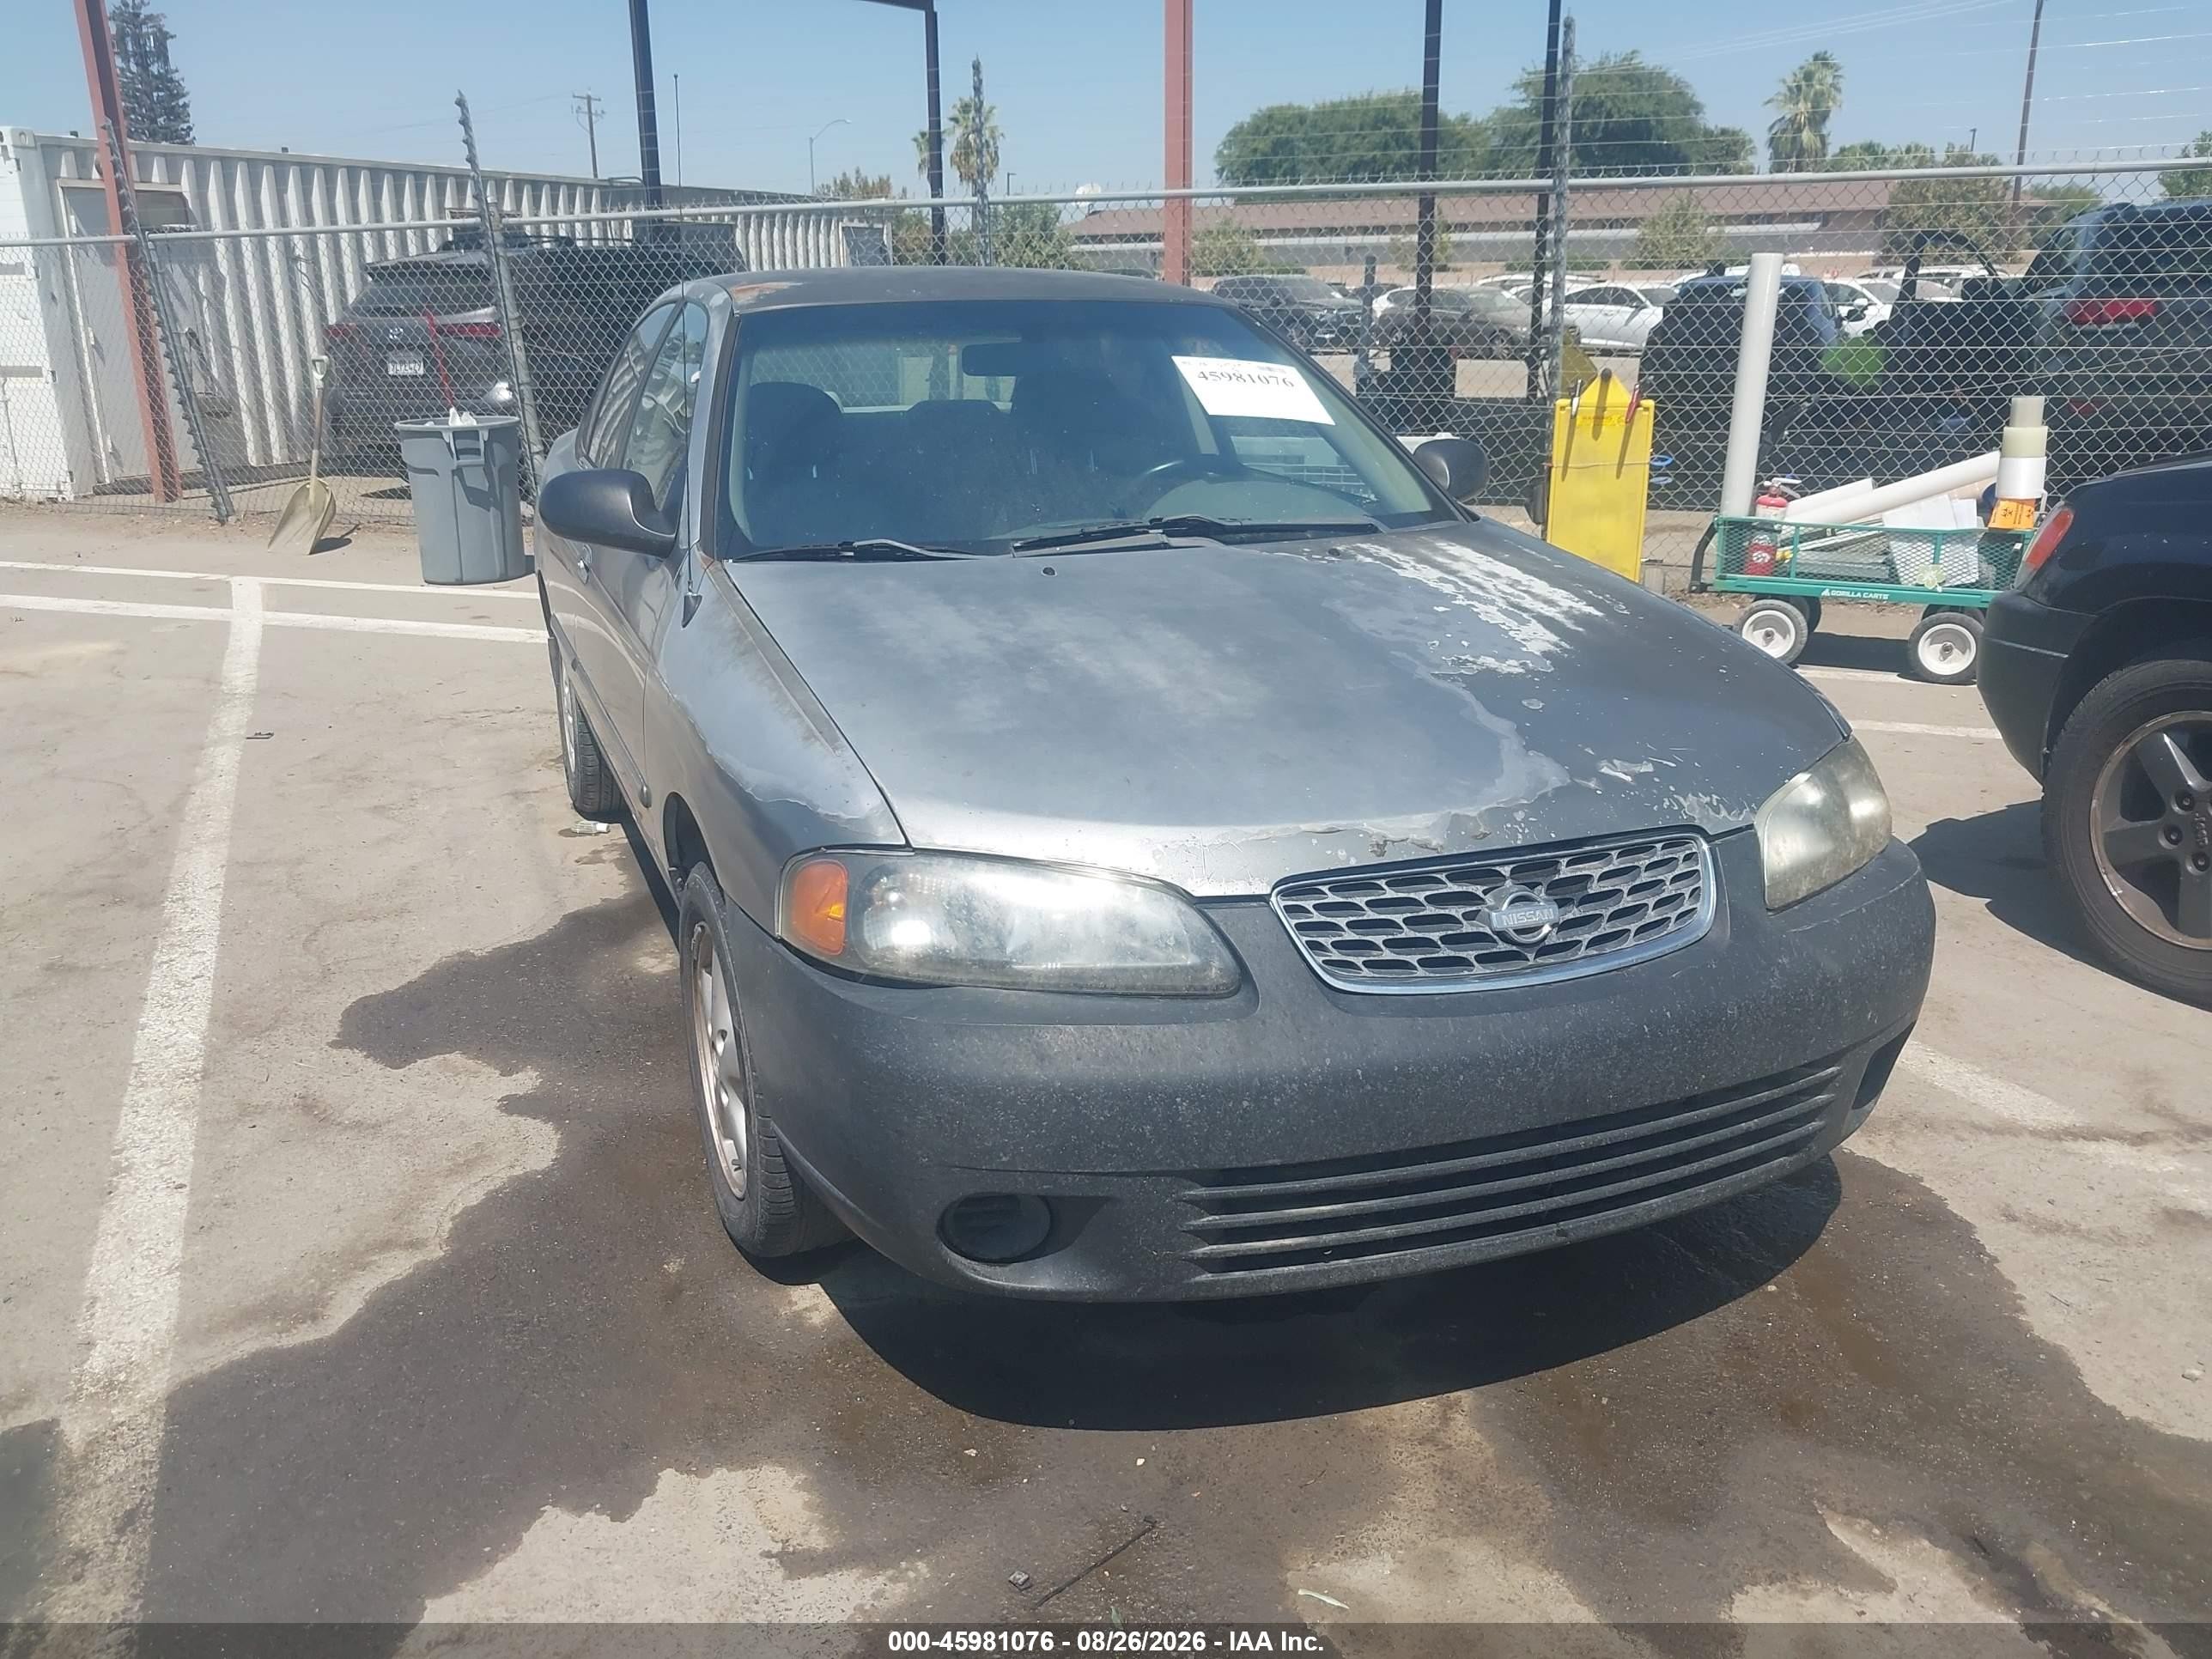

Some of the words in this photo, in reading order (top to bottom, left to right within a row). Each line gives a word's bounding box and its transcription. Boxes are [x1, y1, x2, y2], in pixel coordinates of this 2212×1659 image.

[1197, 371, 1295, 387] 45981076
[1831, 590, 1862, 599] GORILLA
[1502, 908, 1555, 926] NISSAN
